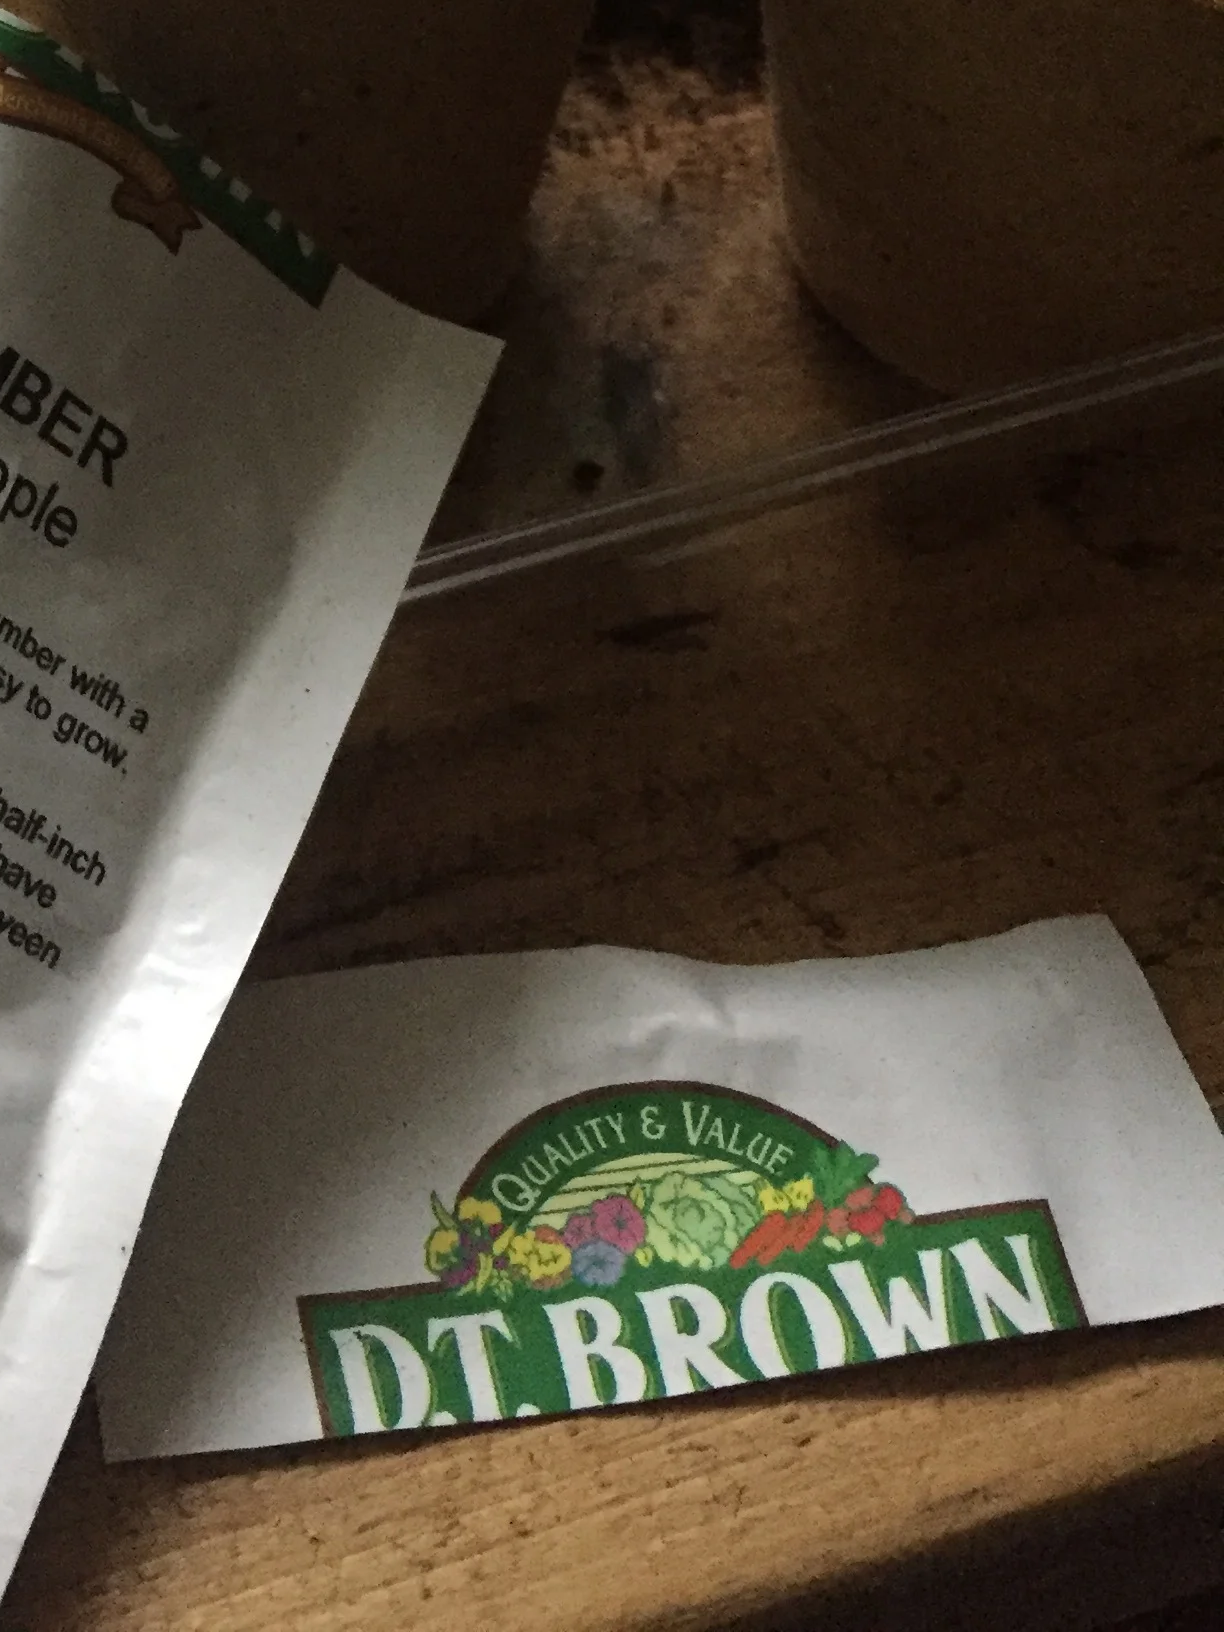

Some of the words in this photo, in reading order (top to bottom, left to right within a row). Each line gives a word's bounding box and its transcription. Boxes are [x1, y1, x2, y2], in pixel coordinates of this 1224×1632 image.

[26, 684, 51, 720] to
[53, 712, 128, 774] grow.
[71, 665, 125, 717] with
[129, 708, 149, 733] a
[492, 1112, 625, 1212] QUALITY
[640, 1106, 666, 1140] &
[681, 1101, 794, 1173] VALUE
[542, 1234, 1057, 1410] BROWN
